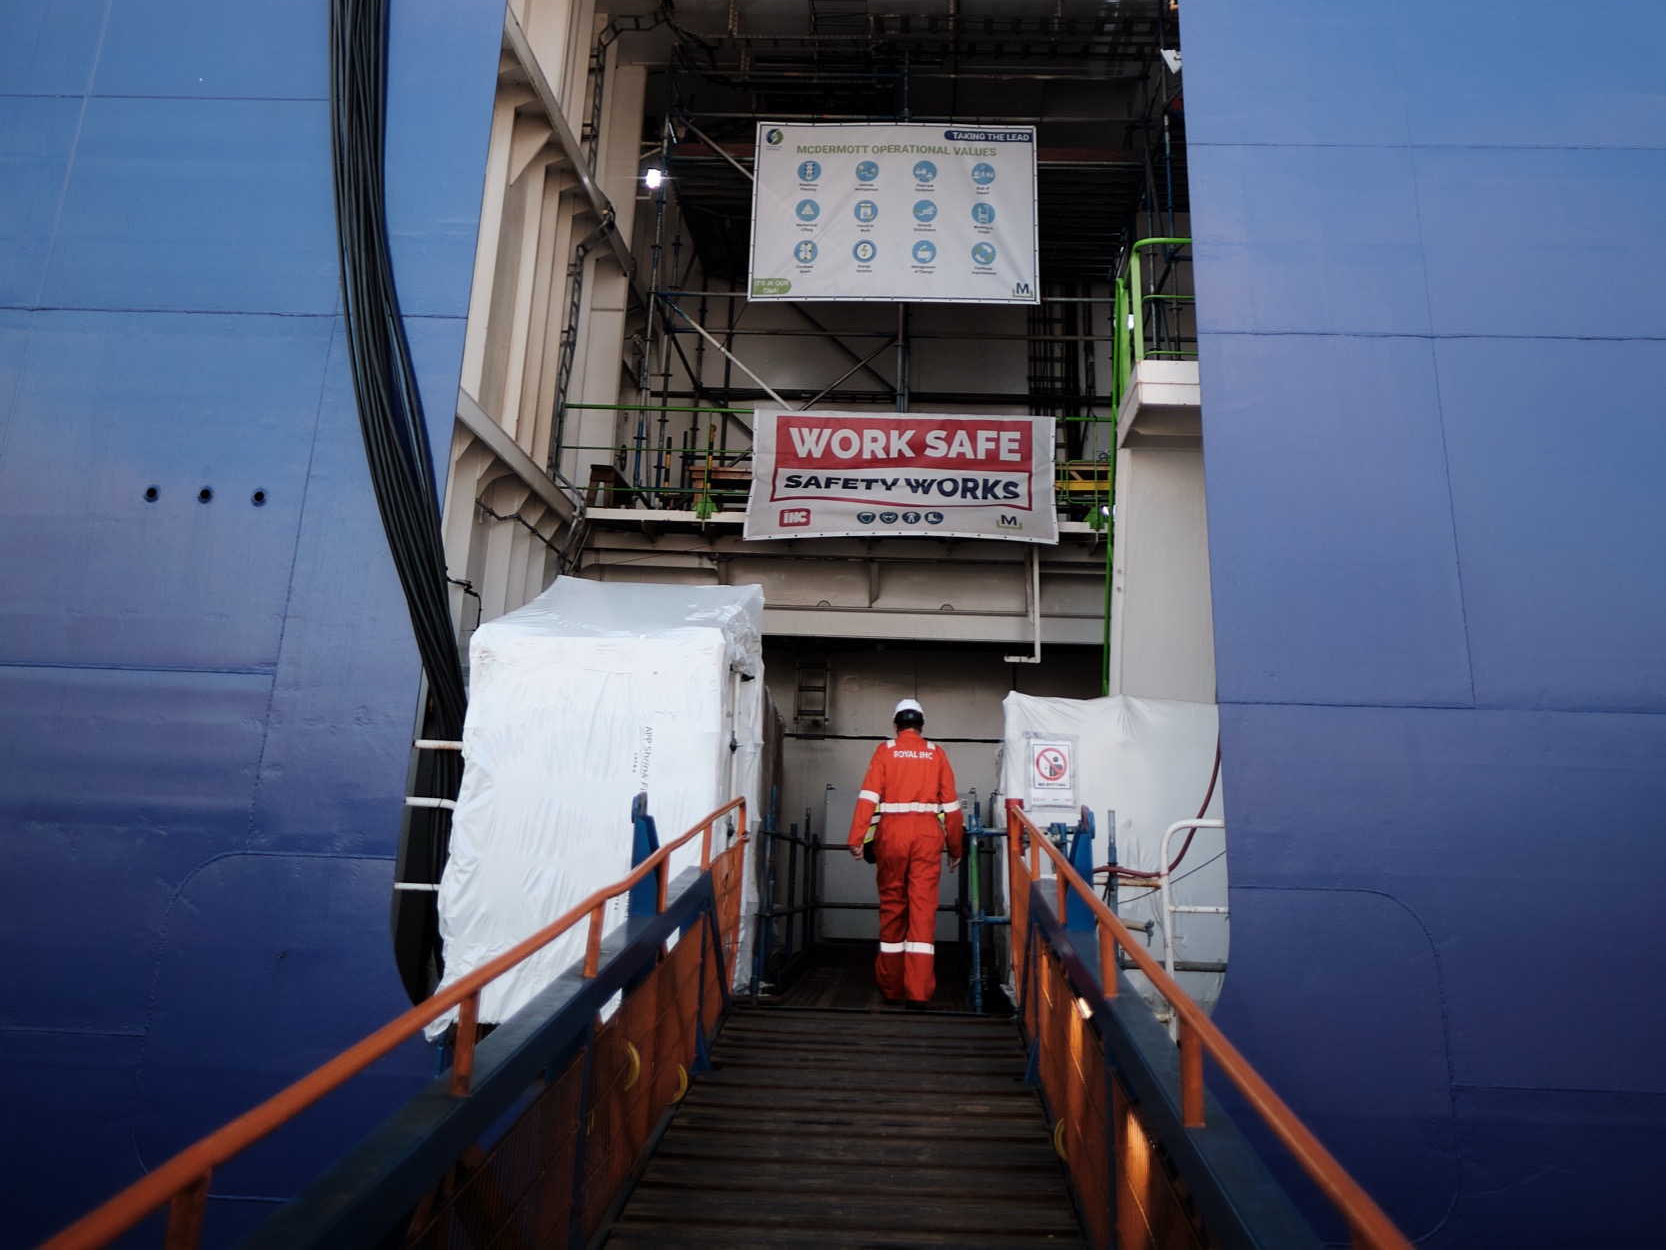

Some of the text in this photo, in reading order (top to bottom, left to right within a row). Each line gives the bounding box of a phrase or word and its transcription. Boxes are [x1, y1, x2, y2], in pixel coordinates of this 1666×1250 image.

[952, 131, 1030, 141] TAKING THE LEAD
[796, 144, 997, 156] MCDERMOTT OPERATIONAL VALUES
[788, 427, 1022, 462] WORK SAFE
[784, 474, 1020, 500] SAFETY WORKS
[644, 726, 652, 744] APP
[640, 746, 652, 780] Shrink
[893, 750, 933, 760] ROYAL IHC
